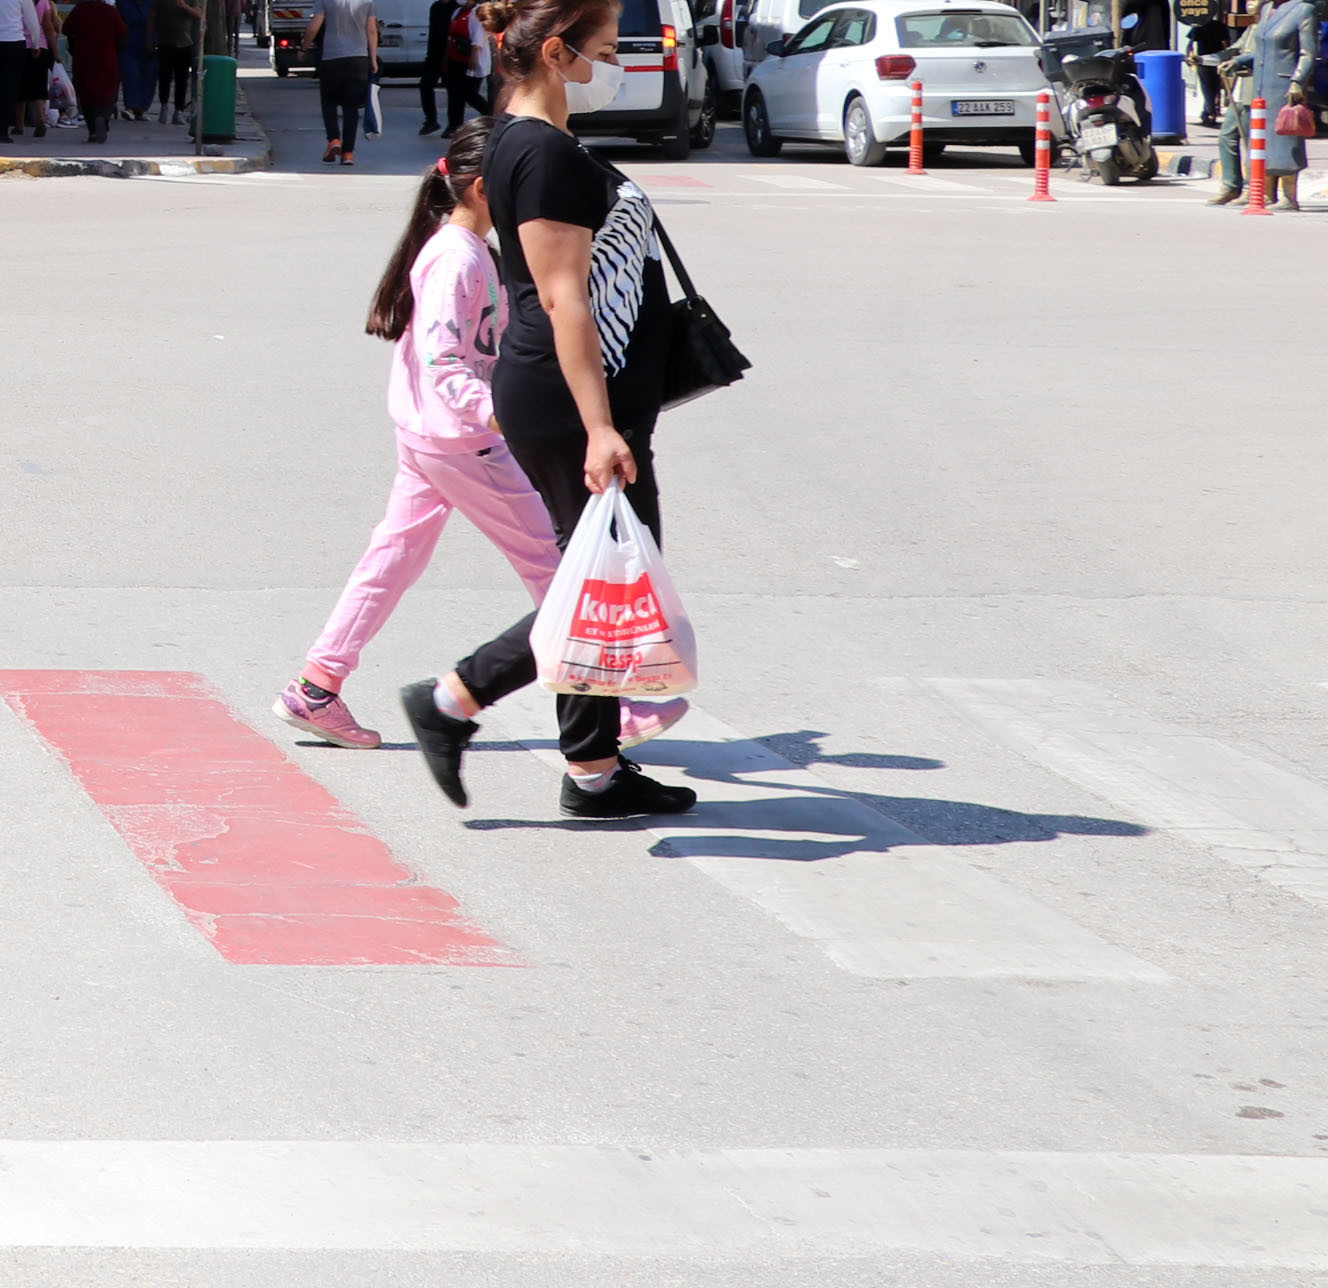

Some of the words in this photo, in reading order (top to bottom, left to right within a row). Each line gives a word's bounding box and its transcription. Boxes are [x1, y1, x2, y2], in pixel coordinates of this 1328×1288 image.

[1181, 7, 1208, 17] yaya
[958, 102, 971, 113] 22
[973, 102, 992, 113] AAK
[993, 101, 1013, 113] 259
